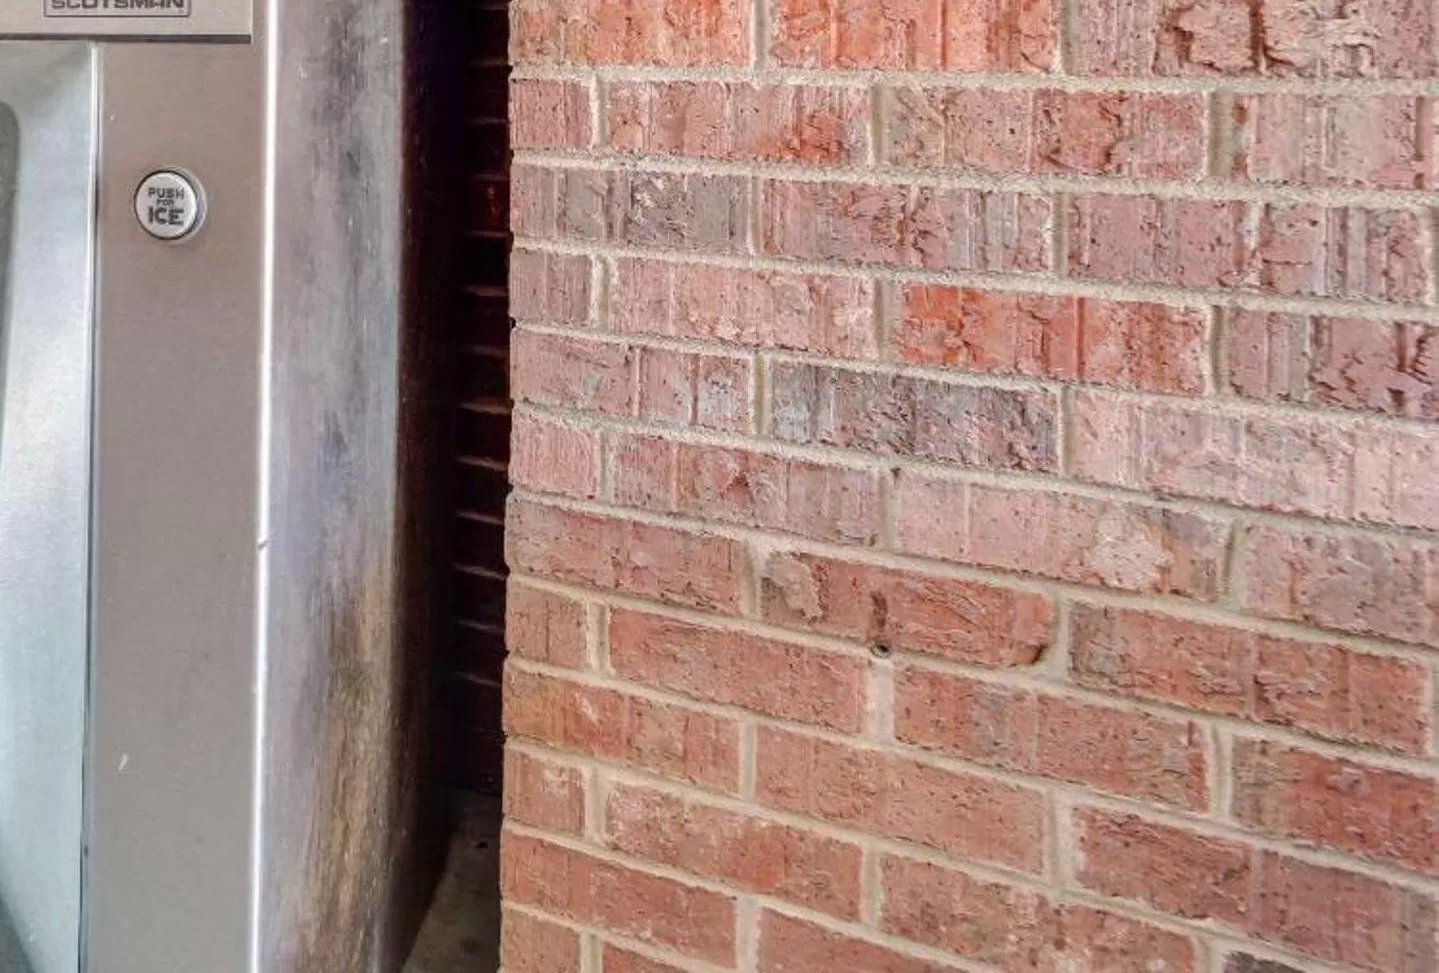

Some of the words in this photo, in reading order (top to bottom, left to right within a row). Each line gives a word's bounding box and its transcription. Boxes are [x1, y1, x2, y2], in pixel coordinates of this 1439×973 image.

[148, 187, 185, 200] PUSH
[156, 199, 175, 207] FOR
[148, 206, 185, 226] ICE
